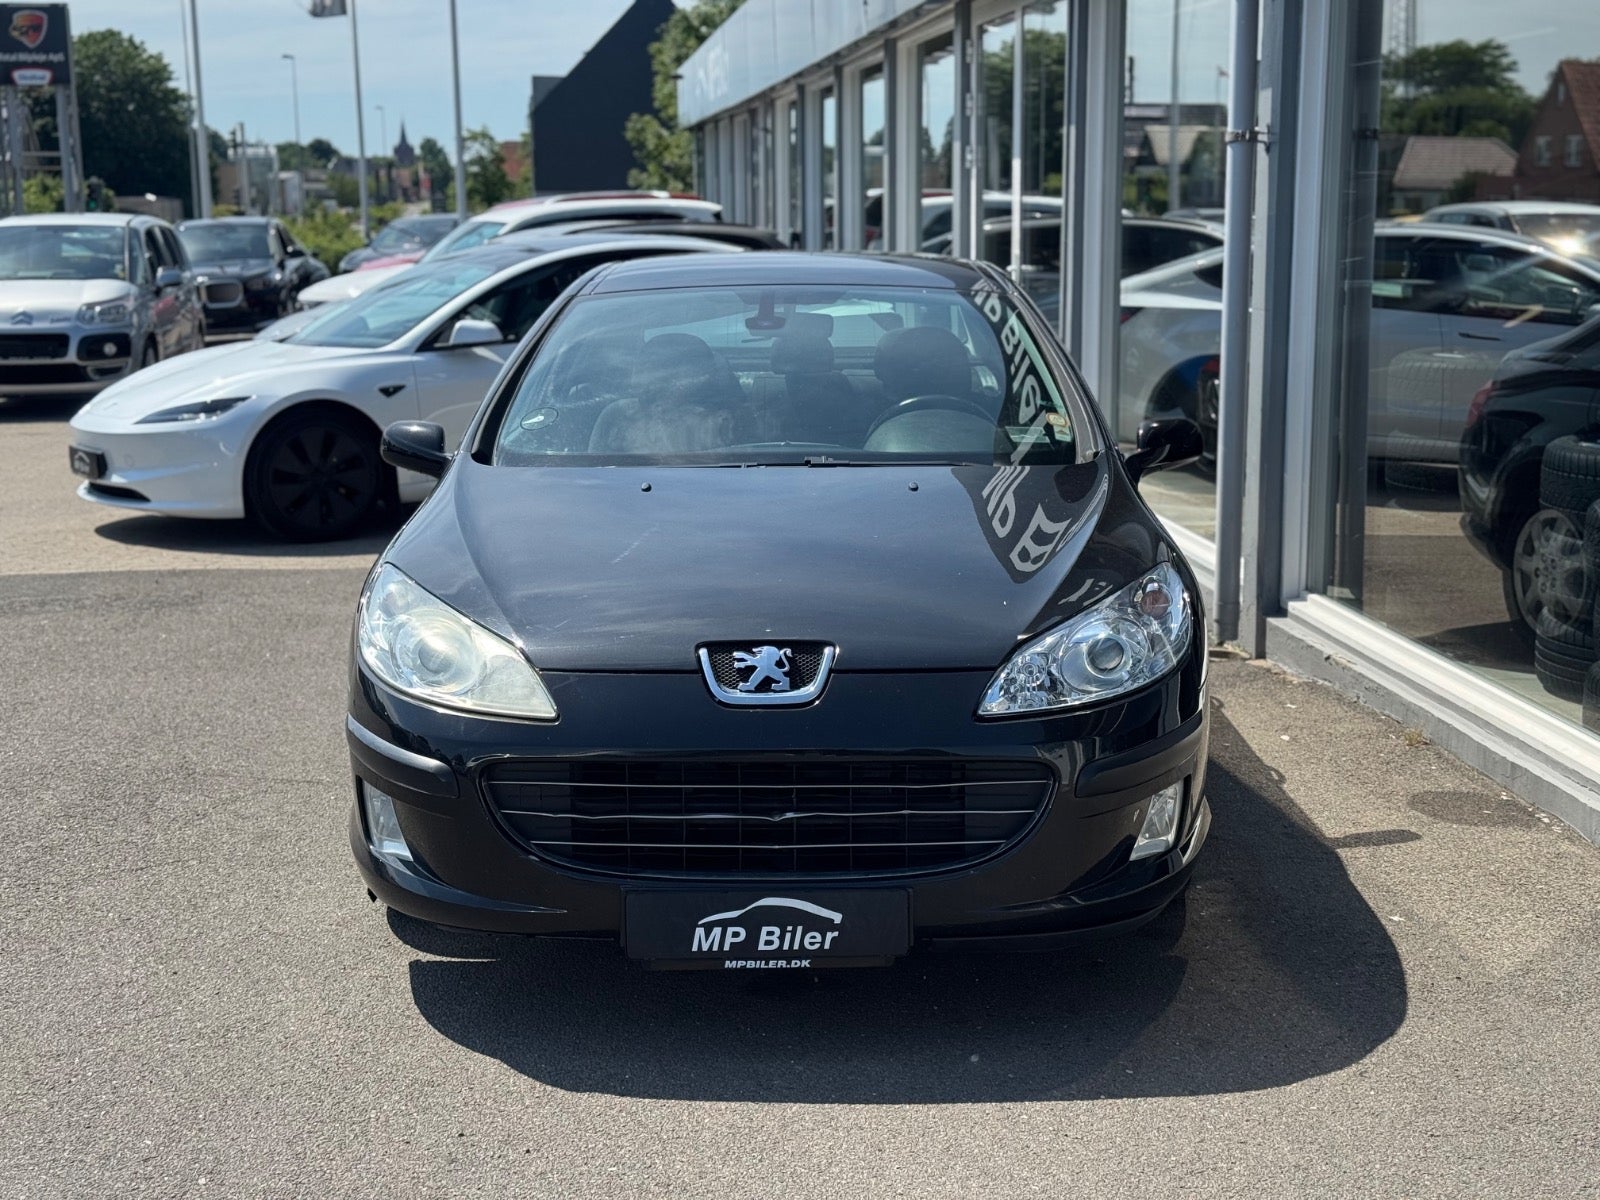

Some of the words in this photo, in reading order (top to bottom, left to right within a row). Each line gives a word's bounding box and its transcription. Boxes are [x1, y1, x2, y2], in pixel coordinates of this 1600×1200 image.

[691, 927, 747, 952] MP
[757, 926, 839, 951] Biler
[724, 959, 811, 969] MPBILER.DK
